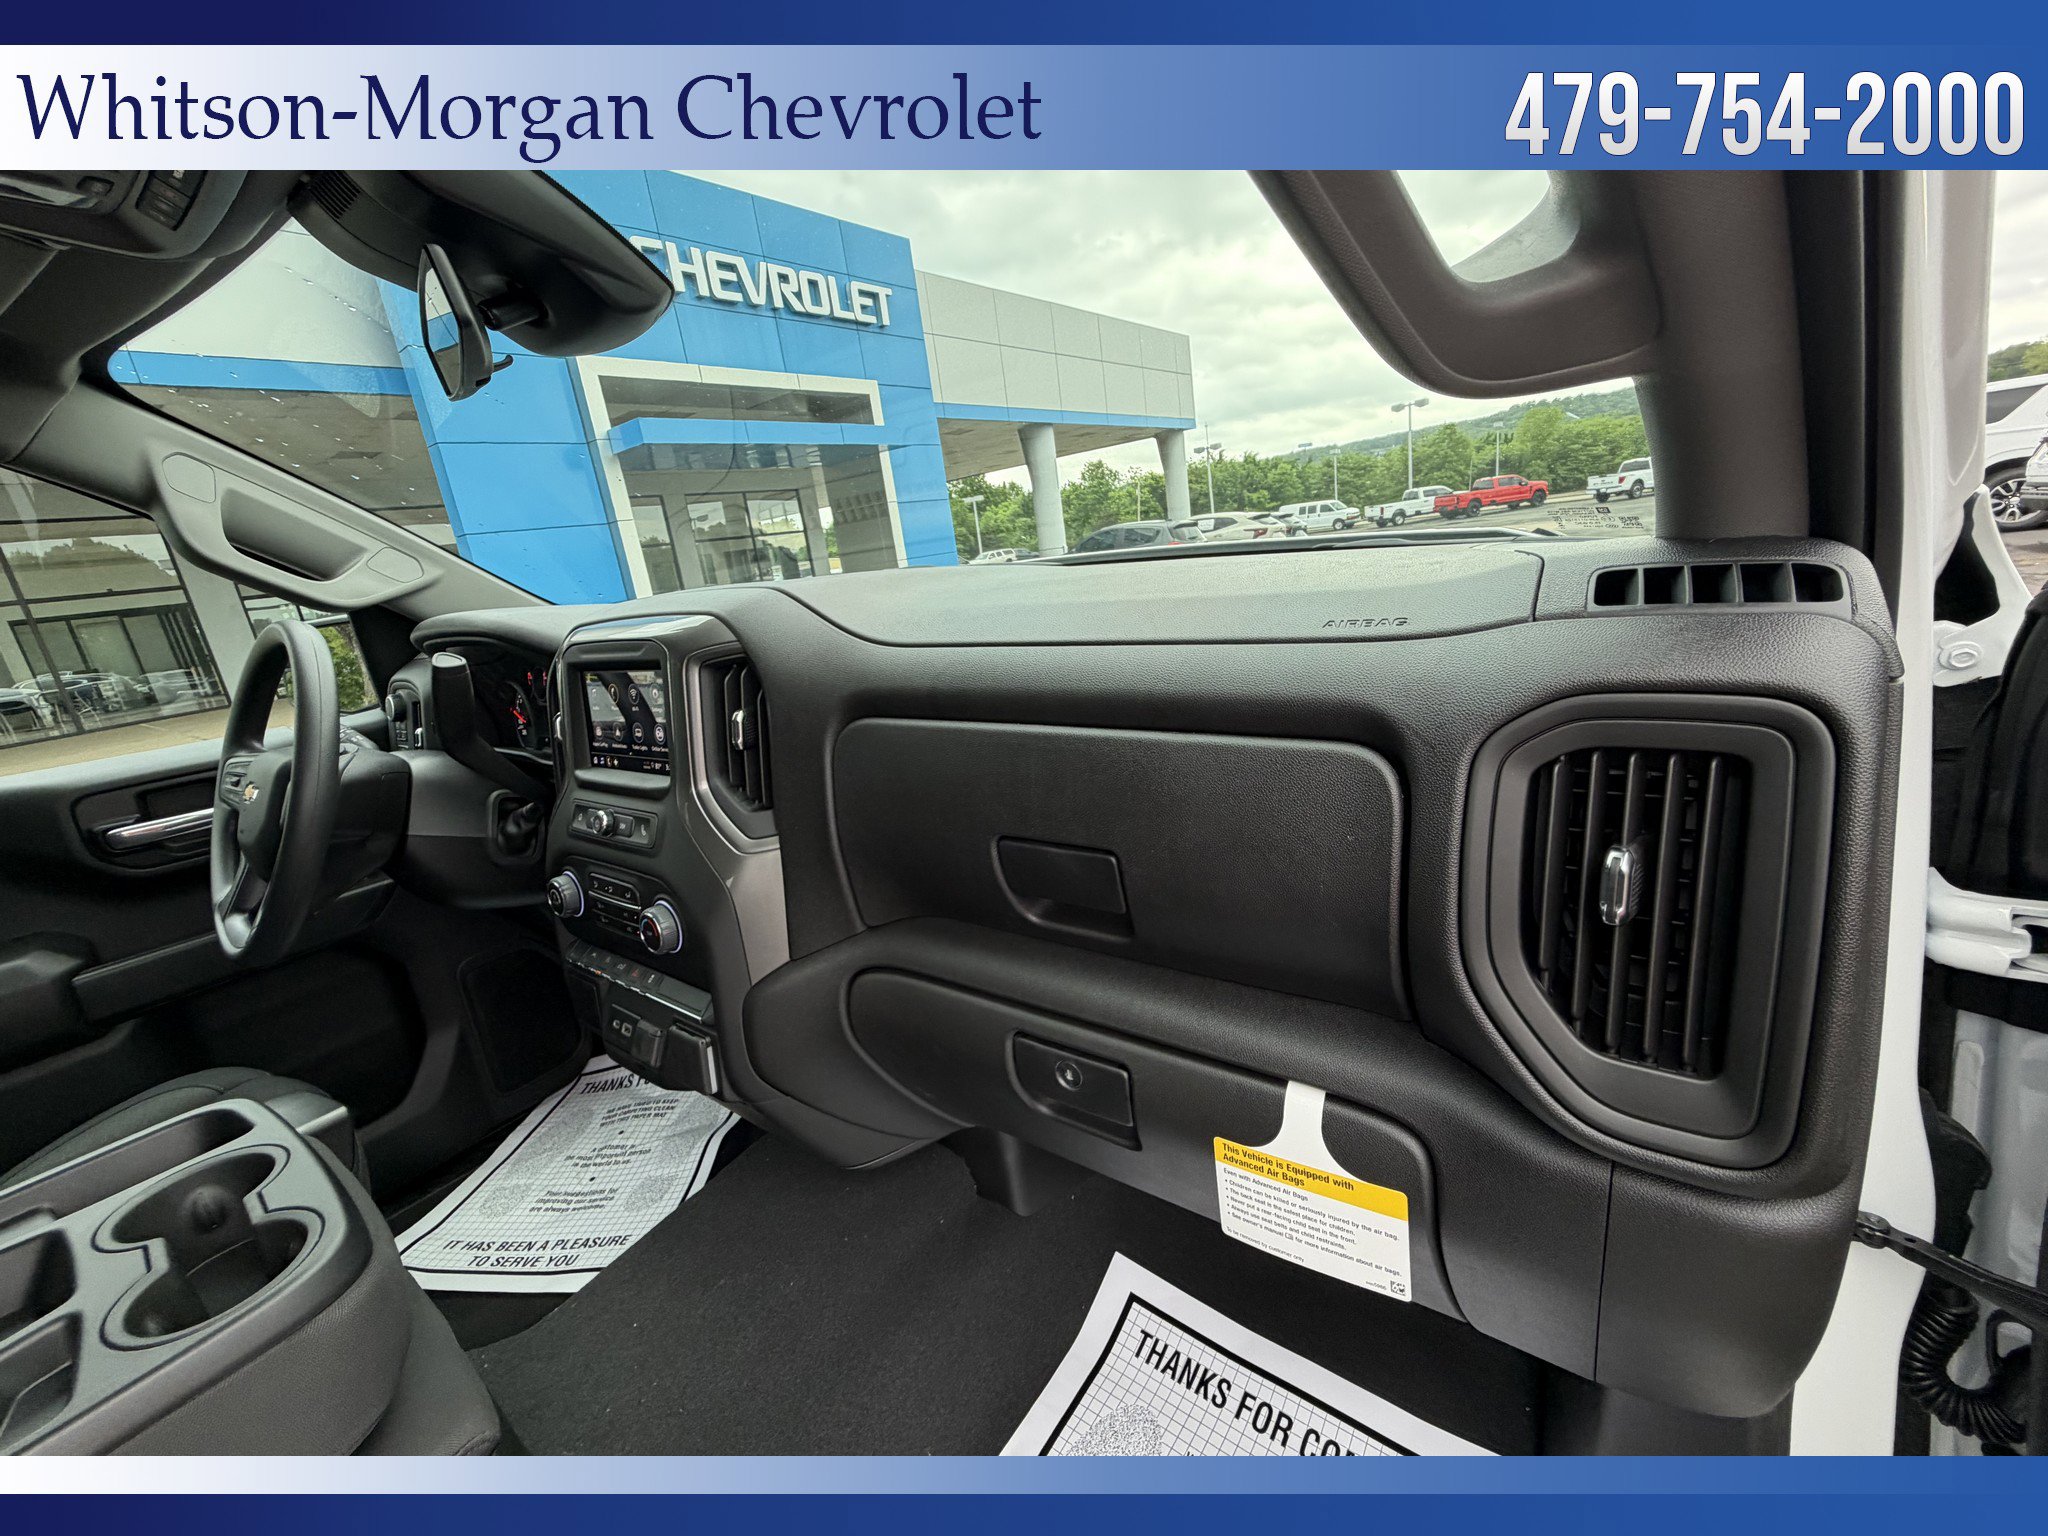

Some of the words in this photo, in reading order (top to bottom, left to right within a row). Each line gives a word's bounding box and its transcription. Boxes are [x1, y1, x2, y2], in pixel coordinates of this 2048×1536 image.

[1321, 617, 1408, 629] AIRBAG
[580, 1073, 635, 1094] THANKS
[1222, 1142, 1240, 1155] This
[1242, 1149, 1273, 1166] Vehicle
[1276, 1160, 1283, 1169] is
[1287, 1164, 1330, 1183] Equipped
[1333, 1178, 1354, 1191] with
[1224, 1153, 1264, 1173] Advanced
[1267, 1168, 1279, 1178] Air
[1282, 1172, 1305, 1186] Bags
[1224, 1168, 1237, 1177] Even
[1239, 1174, 1251, 1182] with
[1252, 1178, 1281, 1192] Advanced
[1282, 1188, 1291, 1196] Air
[1292, 1192, 1308, 1201] Bags
[1229, 1180, 1251, 1192] Children
[1253, 1188, 1263, 1196] can
[1273, 1195, 1289, 1205] killed
[1299, 1205, 1326, 1218] seriously
[1328, 1213, 1350, 1225] injured
[1351, 1221, 1359, 1229] by
[1361, 1224, 1372, 1232] the
[1230, 1196, 1245, 1205] Never
[1261, 1208, 1291, 1223] rear-facing
[1293, 1219, 1306, 1228] child
[1308, 1225, 1320, 1233] seat
[1329, 1232, 1338, 1240] the
[1231, 1204, 1249, 1215] Always
[1274, 1221, 1287, 1230] belts
[1301, 1232, 1315, 1240] child
[1240, 1192, 1253, 1200] back
[1283, 1208, 1300, 1217] safest
[1302, 1214, 1317, 1223] place
[443, 1239, 463, 1250] IT
[461, 1240, 496, 1251] HAS
[494, 1240, 537, 1252] BEEN
[535, 1239, 551, 1252] A
[551, 1234, 632, 1250] PLEASURE
[1232, 1212, 1241, 1220] See
[1264, 1226, 1284, 1236] manual
[1304, 1241, 1319, 1249] more
[1320, 1245, 1354, 1262] information
[1356, 1258, 1373, 1267] about
[1375, 1263, 1383, 1271] air
[466, 1255, 491, 1267] TO
[490, 1255, 545, 1267] SERVE
[545, 1254, 580, 1267] YOU
[1134, 1329, 1232, 1409] THANKS
[1234, 1391, 1294, 1448] FOR
[1300, 1428, 1356, 1456] CO
